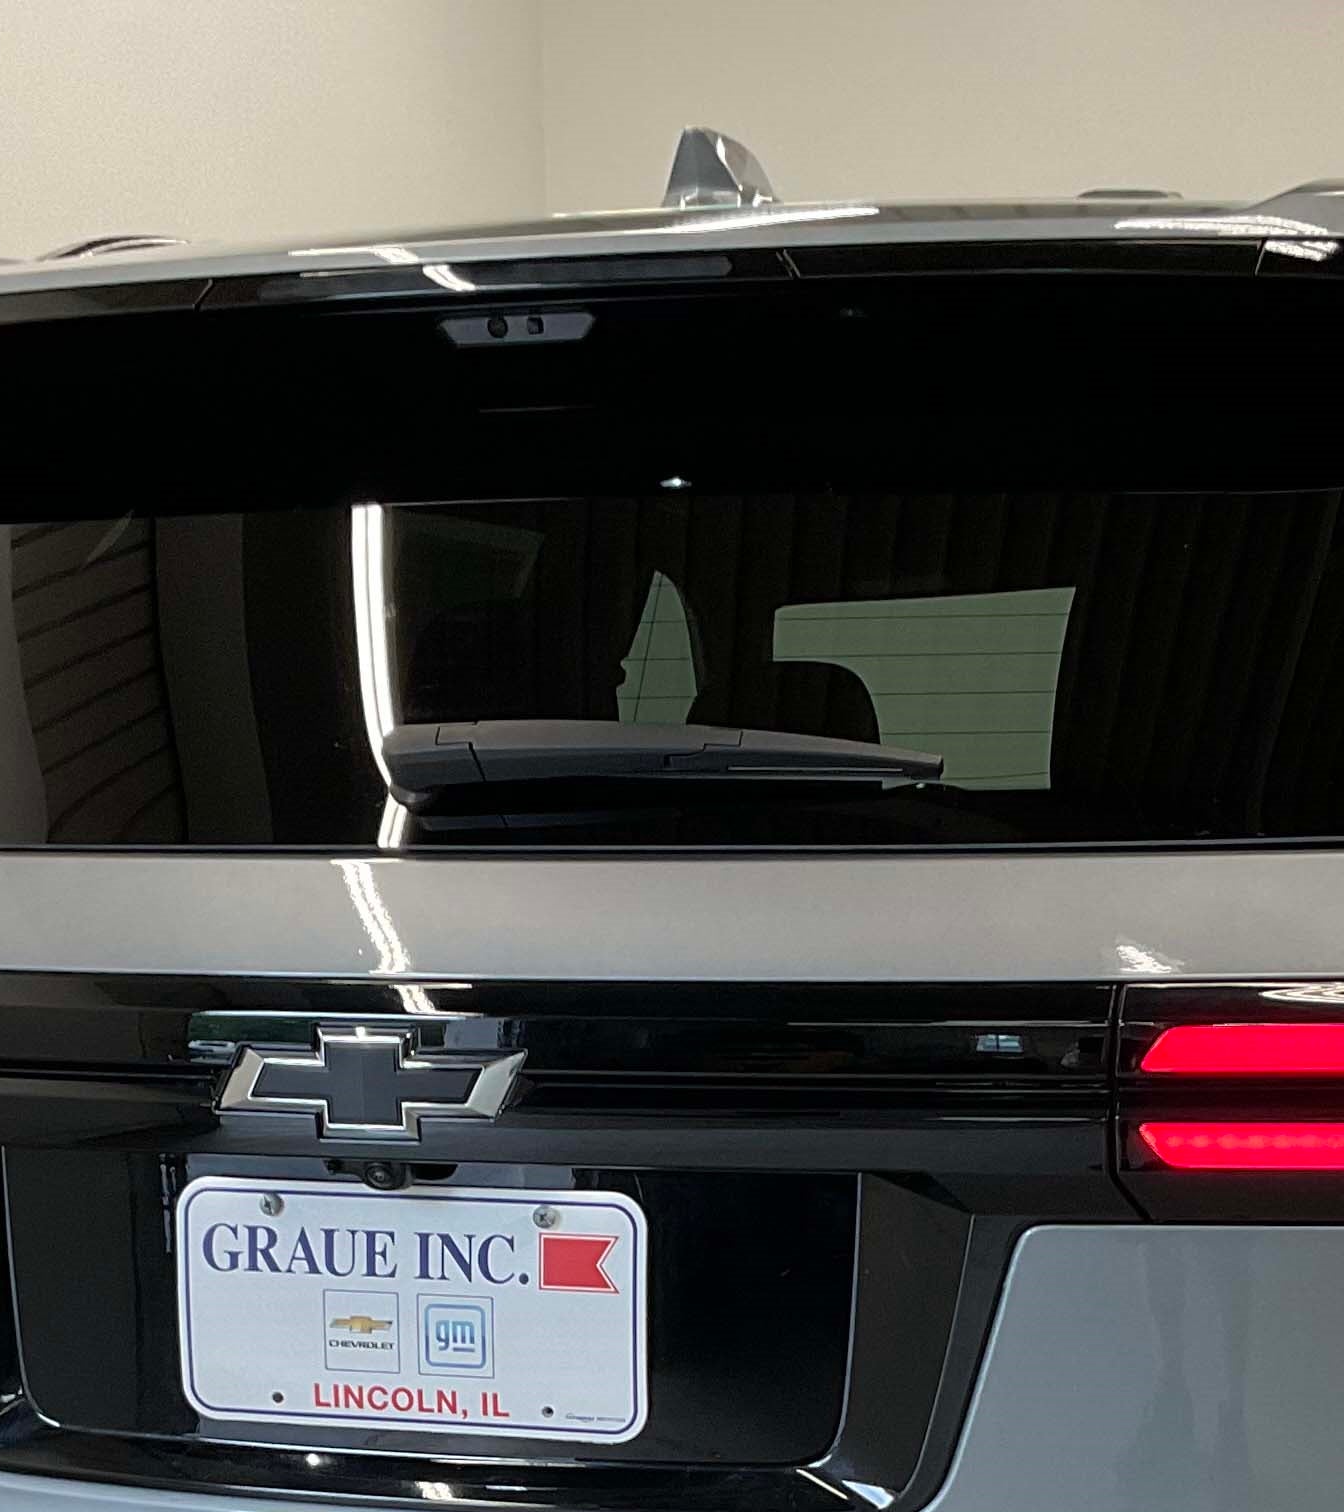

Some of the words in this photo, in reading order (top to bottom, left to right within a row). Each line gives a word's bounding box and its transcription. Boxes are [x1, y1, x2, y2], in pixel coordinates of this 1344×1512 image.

[202, 1222, 398, 1278] GRAUE
[414, 1232, 530, 1286] INC.
[328, 1338, 396, 1352] CHEVROLET
[435, 1318, 476, 1353] gm
[312, 1382, 469, 1419] LINCOLN,
[481, 1392, 510, 1418] IL
